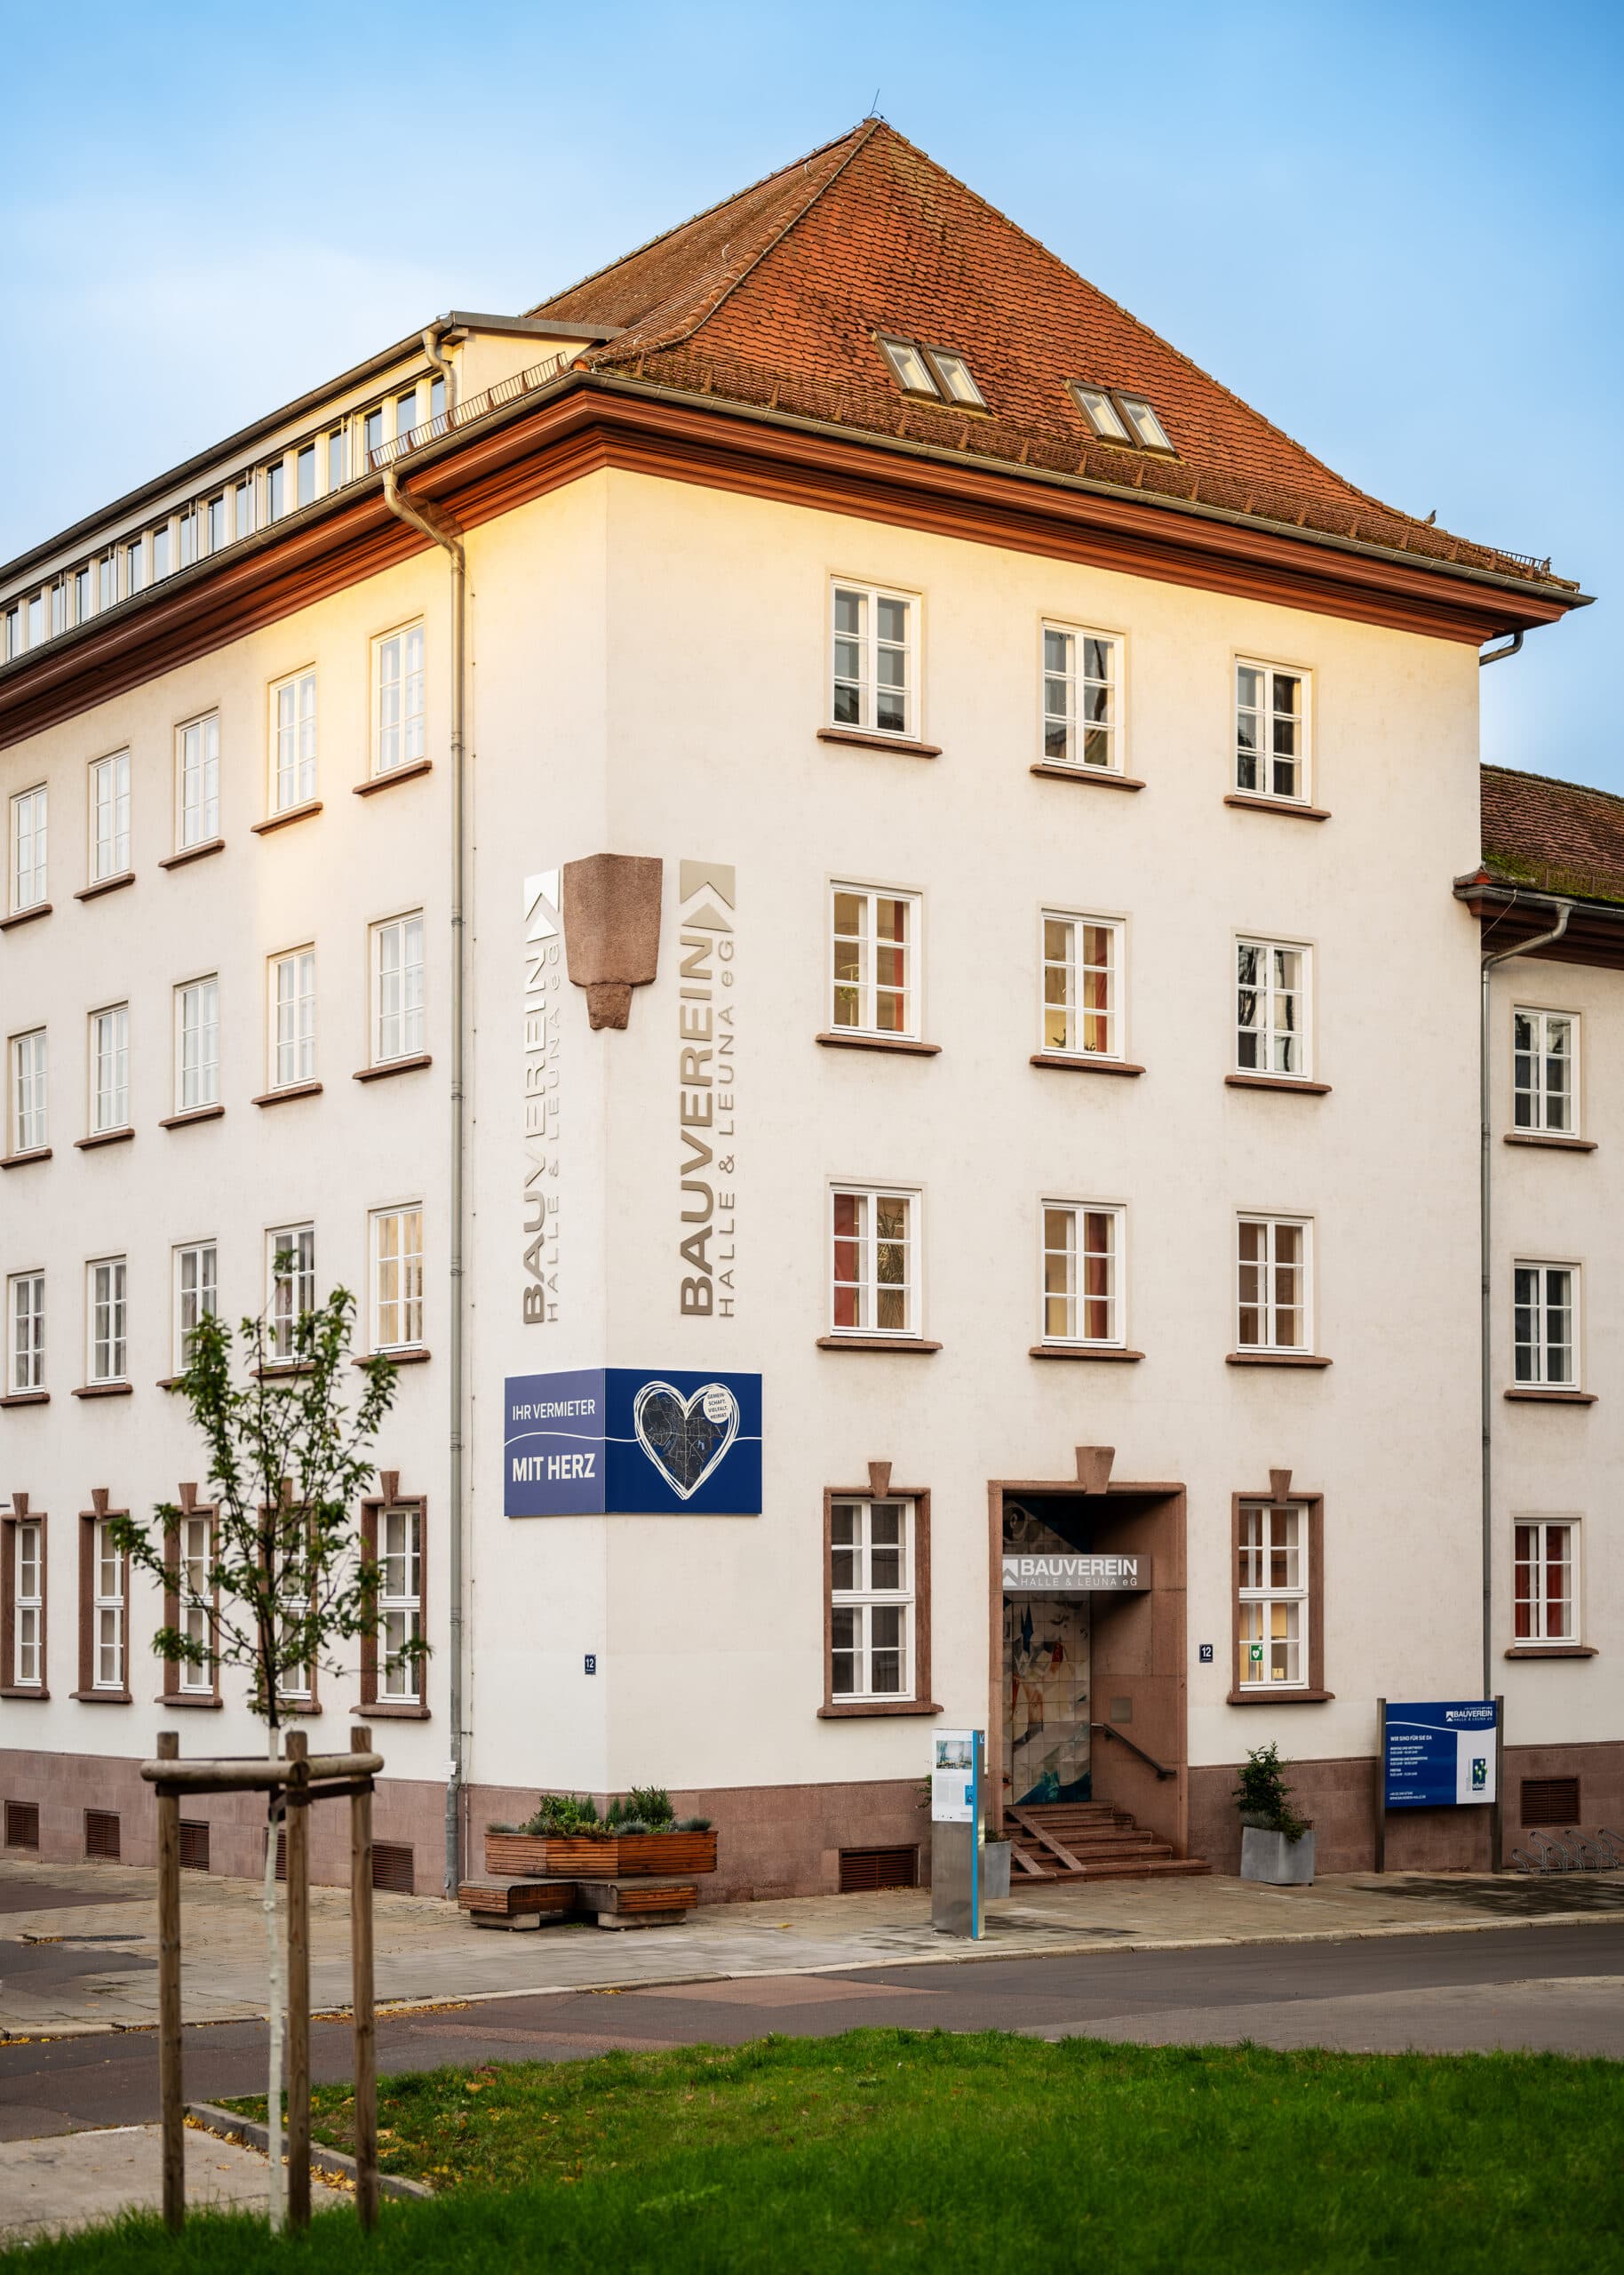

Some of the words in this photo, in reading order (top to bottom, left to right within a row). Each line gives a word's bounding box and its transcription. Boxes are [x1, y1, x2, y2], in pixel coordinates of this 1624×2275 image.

[547, 943, 560, 991] eG
[718, 939, 735, 987] eG
[547, 1007, 560, 1140] LEUNA
[718, 1005, 735, 1136] LEUNA
[523, 948, 546, 1324] BAUVEREIN
[680, 935, 714, 1316] BAUVEREIN
[548, 1159, 559, 1177] &
[718, 1153, 735, 1174] &
[547, 1195, 559, 1322] HALLE
[719, 1192, 735, 1318] HALLE
[513, 1404, 531, 1421] IHR
[533, 1399, 596, 1419] VERMIETER
[513, 1457, 545, 1482] MIT
[547, 1453, 596, 1481] HERZ
[1021, 1559, 1138, 1576] BAUVEREIN
[1021, 1577, 1059, 1586] HALLE
[1065, 1577, 1072, 1586] &
[1078, 1577, 1117, 1586] LEUNA
[1122, 1577, 1138, 1586] eG
[585, 1658, 594, 1668] 12
[1201, 1646, 1212, 1657] 12
